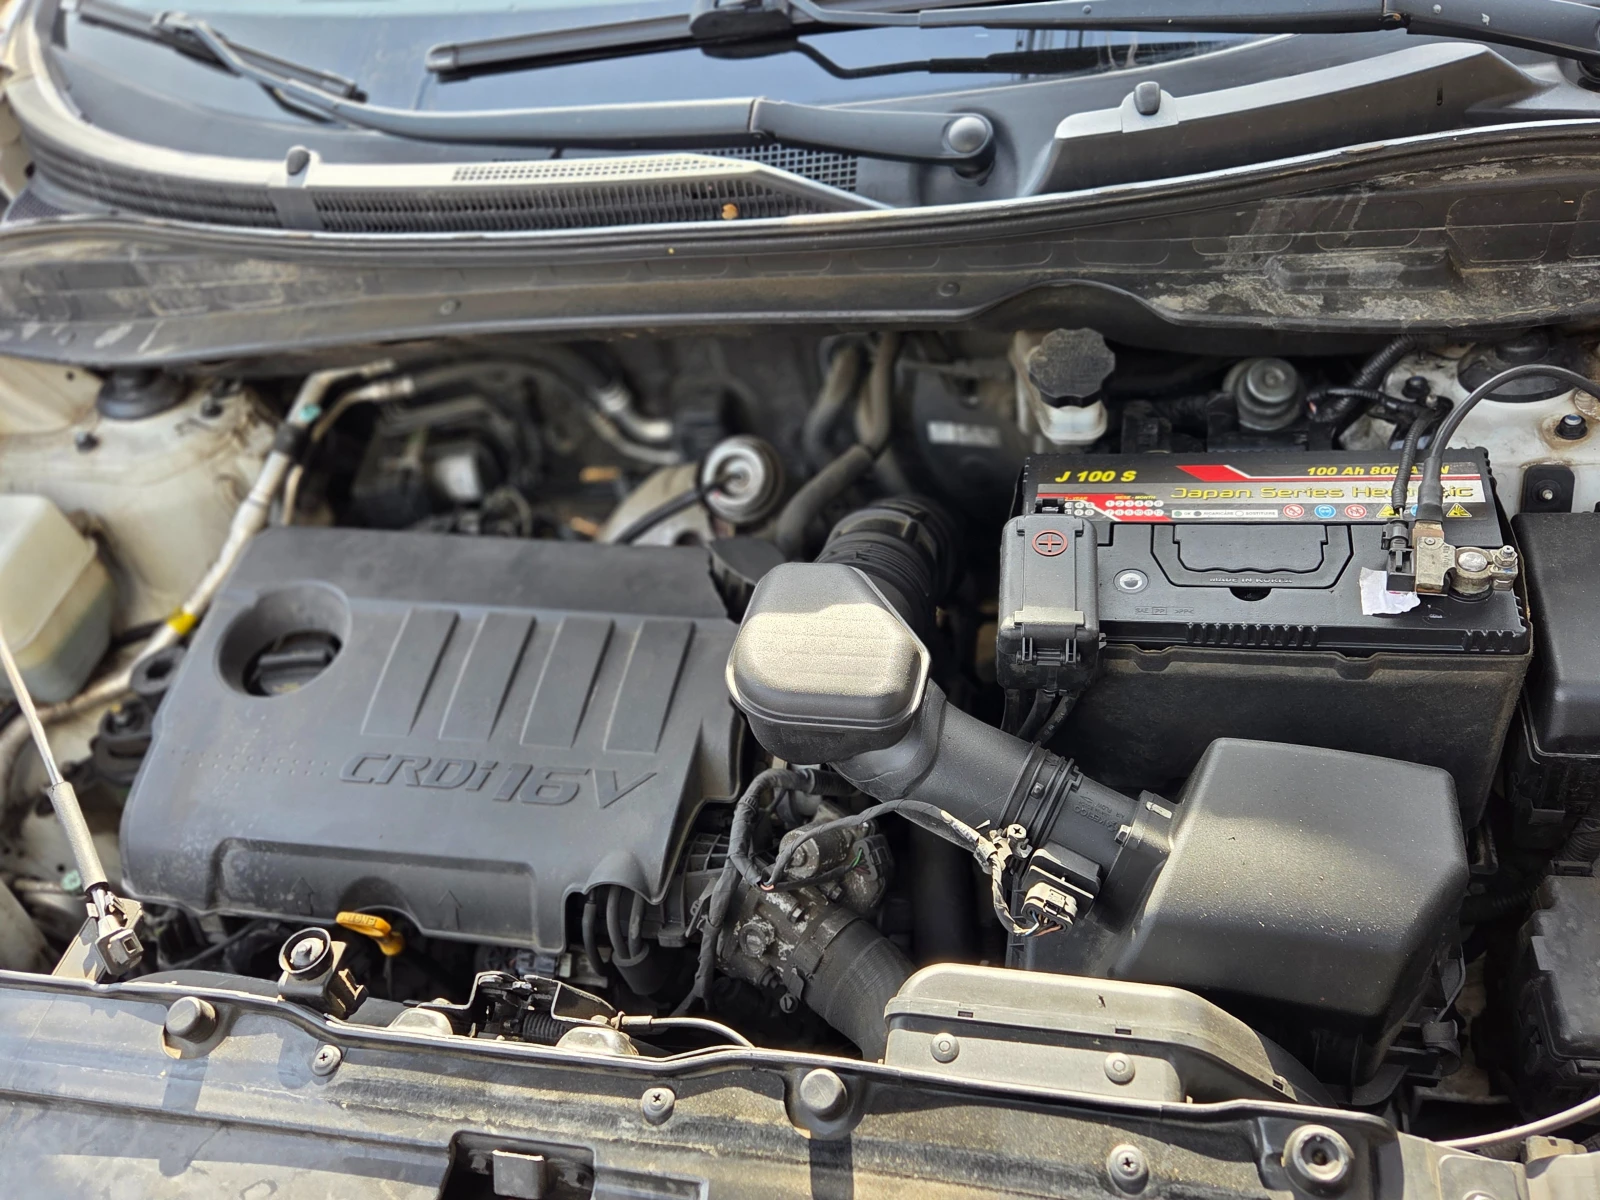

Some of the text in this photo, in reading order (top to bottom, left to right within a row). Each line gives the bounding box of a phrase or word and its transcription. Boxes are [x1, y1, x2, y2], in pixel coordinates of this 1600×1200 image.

[1055, 470, 1138, 483] J 100 S
[1307, 466, 1339, 476] 100
[1341, 466, 1364, 476] Ah
[1170, 487, 1251, 500] Japan
[1260, 487, 1343, 498] Series
